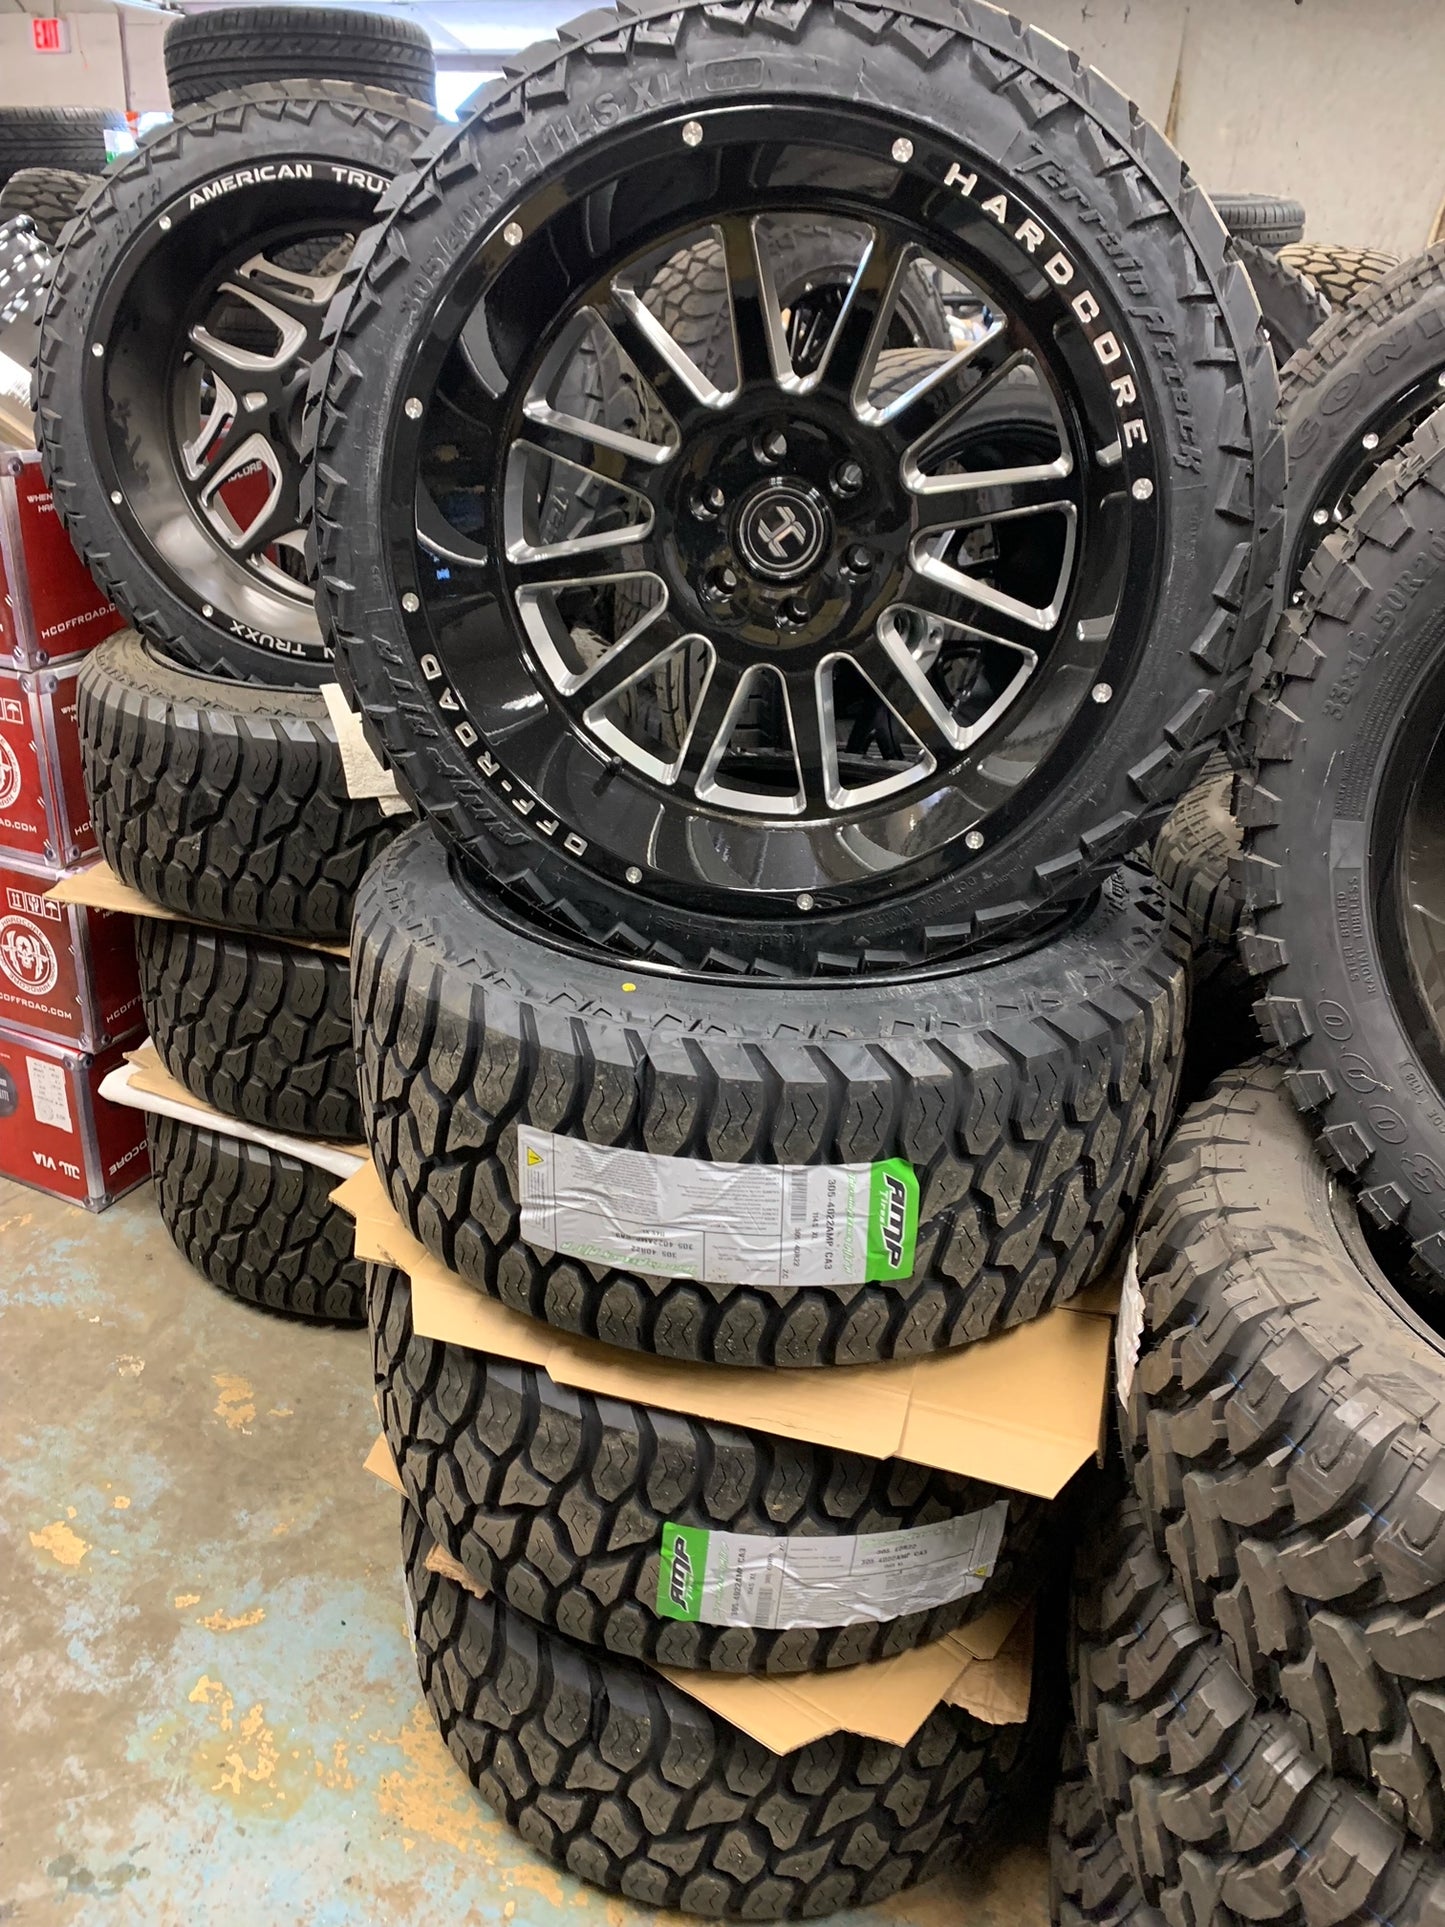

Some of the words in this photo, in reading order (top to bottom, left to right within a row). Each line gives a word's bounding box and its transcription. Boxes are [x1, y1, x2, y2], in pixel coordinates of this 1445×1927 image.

[33, 19, 59, 49] EXIT
[189, 164, 313, 210] AMERICAN
[944, 162, 1148, 448] HARDCORE
[1014, 141, 1147, 295] Terrain
[1128, 306, 1203, 474] Attack
[230, 620, 306, 657] TRUXX
[420, 654, 588, 857] OFF-ROAD
[32, 1151, 57, 1171] VIA
[109, 1138, 150, 1176] DCORE
[882, 1171, 907, 1269] AMP
[669, 1534, 693, 1613] AMP
